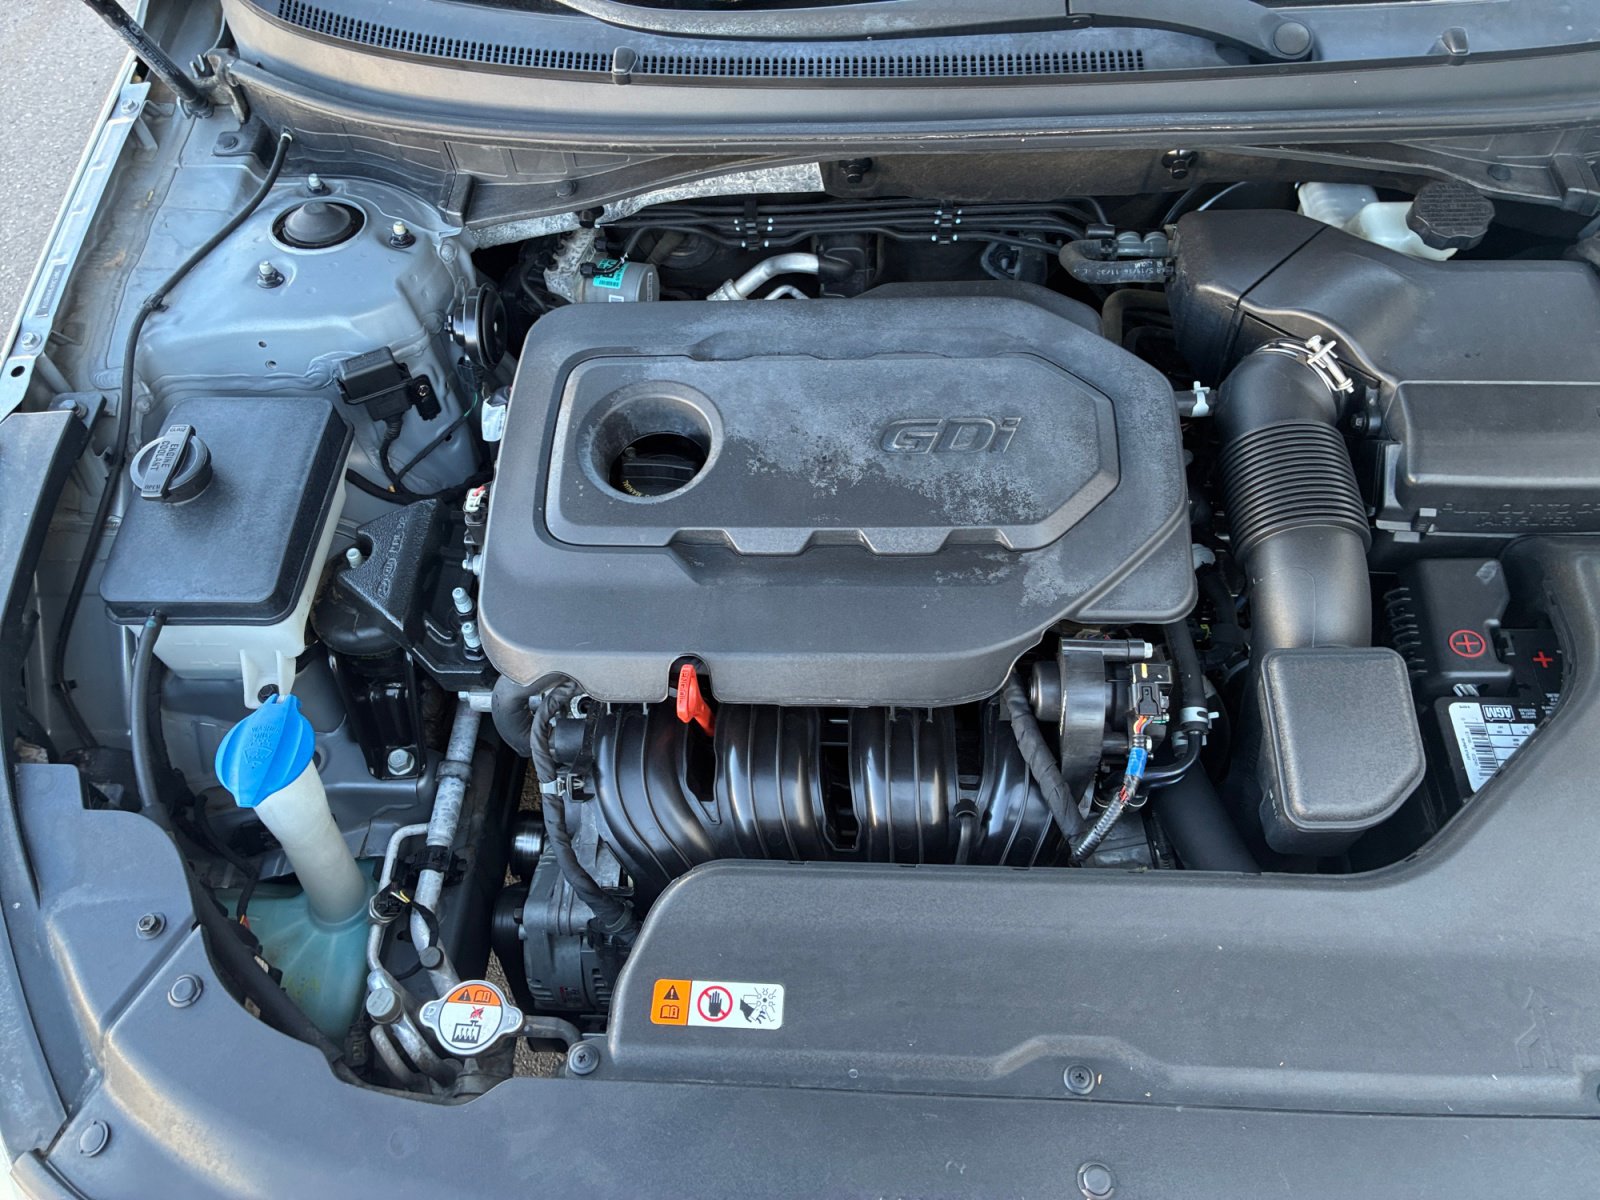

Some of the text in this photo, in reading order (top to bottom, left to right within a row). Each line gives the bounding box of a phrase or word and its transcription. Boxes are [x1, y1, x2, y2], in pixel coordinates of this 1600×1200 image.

[879, 416, 1021, 454] GDi
[150, 440, 170, 471] COOLANT
[161, 443, 179, 468] ENGINE
[1484, 706, 1512, 718] AGM
